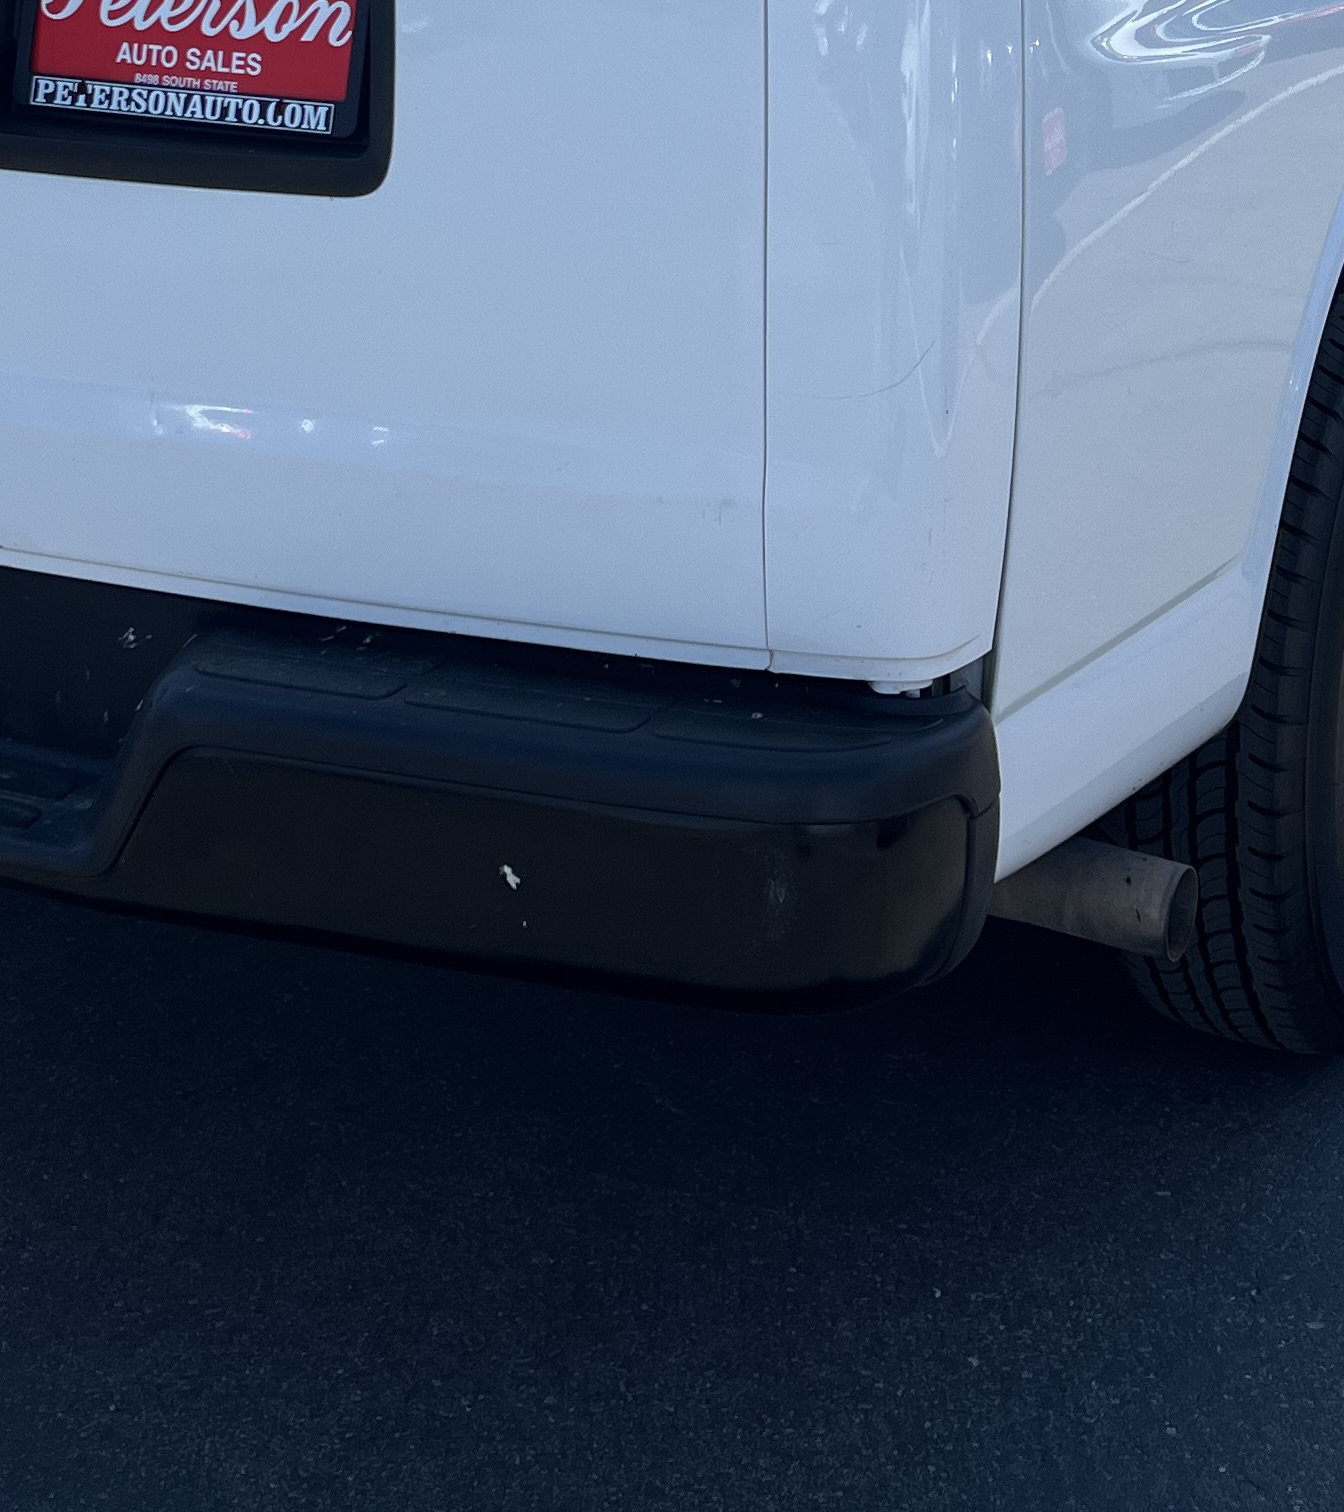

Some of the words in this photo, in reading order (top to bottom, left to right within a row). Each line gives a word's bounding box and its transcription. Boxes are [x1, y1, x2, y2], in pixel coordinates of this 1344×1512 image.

[116, 42, 178, 70] AUTO
[186, 47, 262, 76] SALES
[162, 75, 200, 88] SOUTH
[203, 78, 238, 92] STATE
